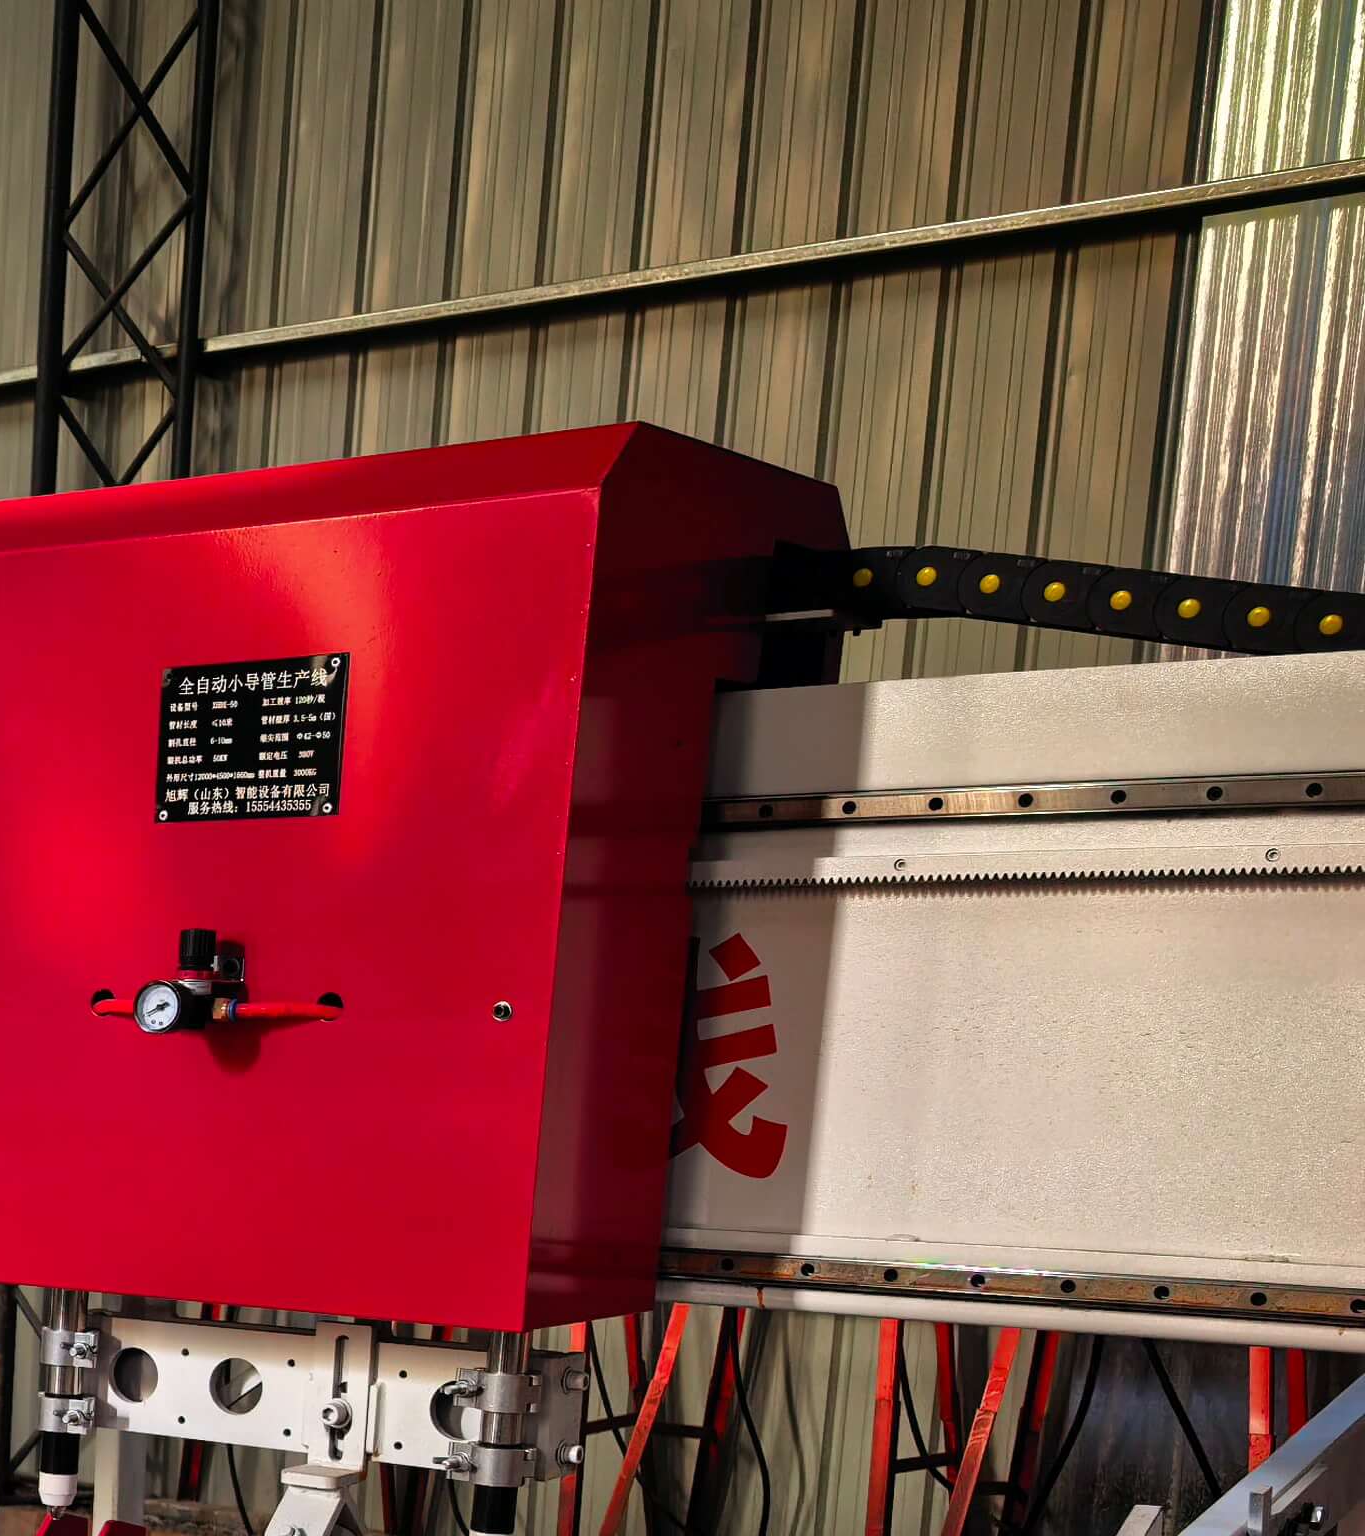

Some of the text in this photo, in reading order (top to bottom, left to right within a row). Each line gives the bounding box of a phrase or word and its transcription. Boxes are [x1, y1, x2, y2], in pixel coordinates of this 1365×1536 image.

[178, 668, 328, 696] 全自动小导管生产线
